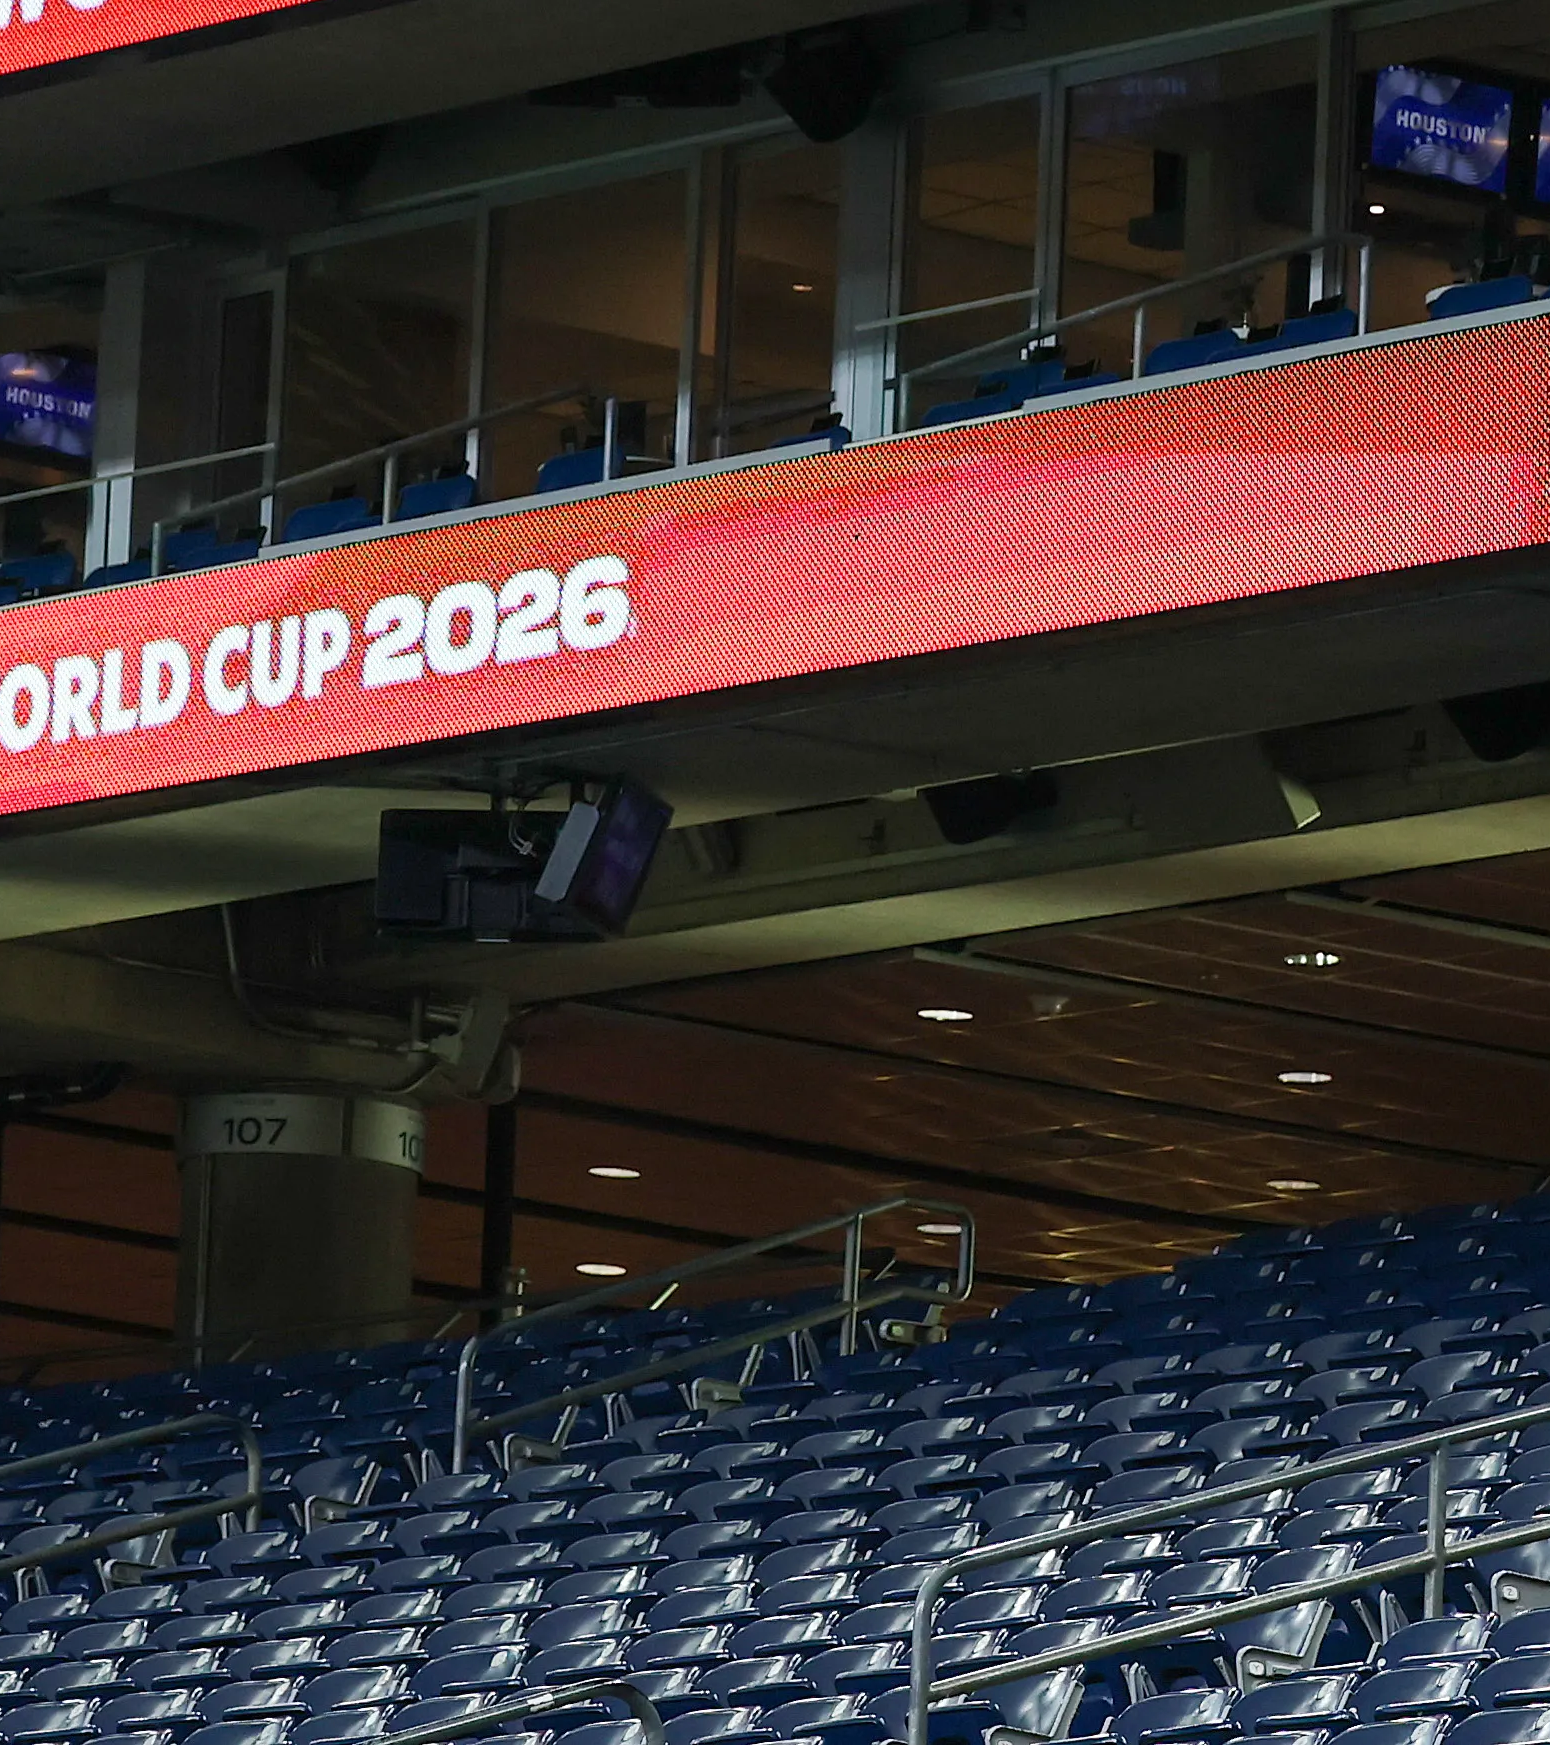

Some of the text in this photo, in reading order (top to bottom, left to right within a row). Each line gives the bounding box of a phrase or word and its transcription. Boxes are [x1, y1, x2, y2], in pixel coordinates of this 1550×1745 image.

[1396, 108, 1487, 144] HOUSTON
[202, 605, 353, 717] CUP
[361, 553, 632, 688] 2026
[223, 1116, 288, 1147] 107
[398, 1130, 423, 1162] 10
